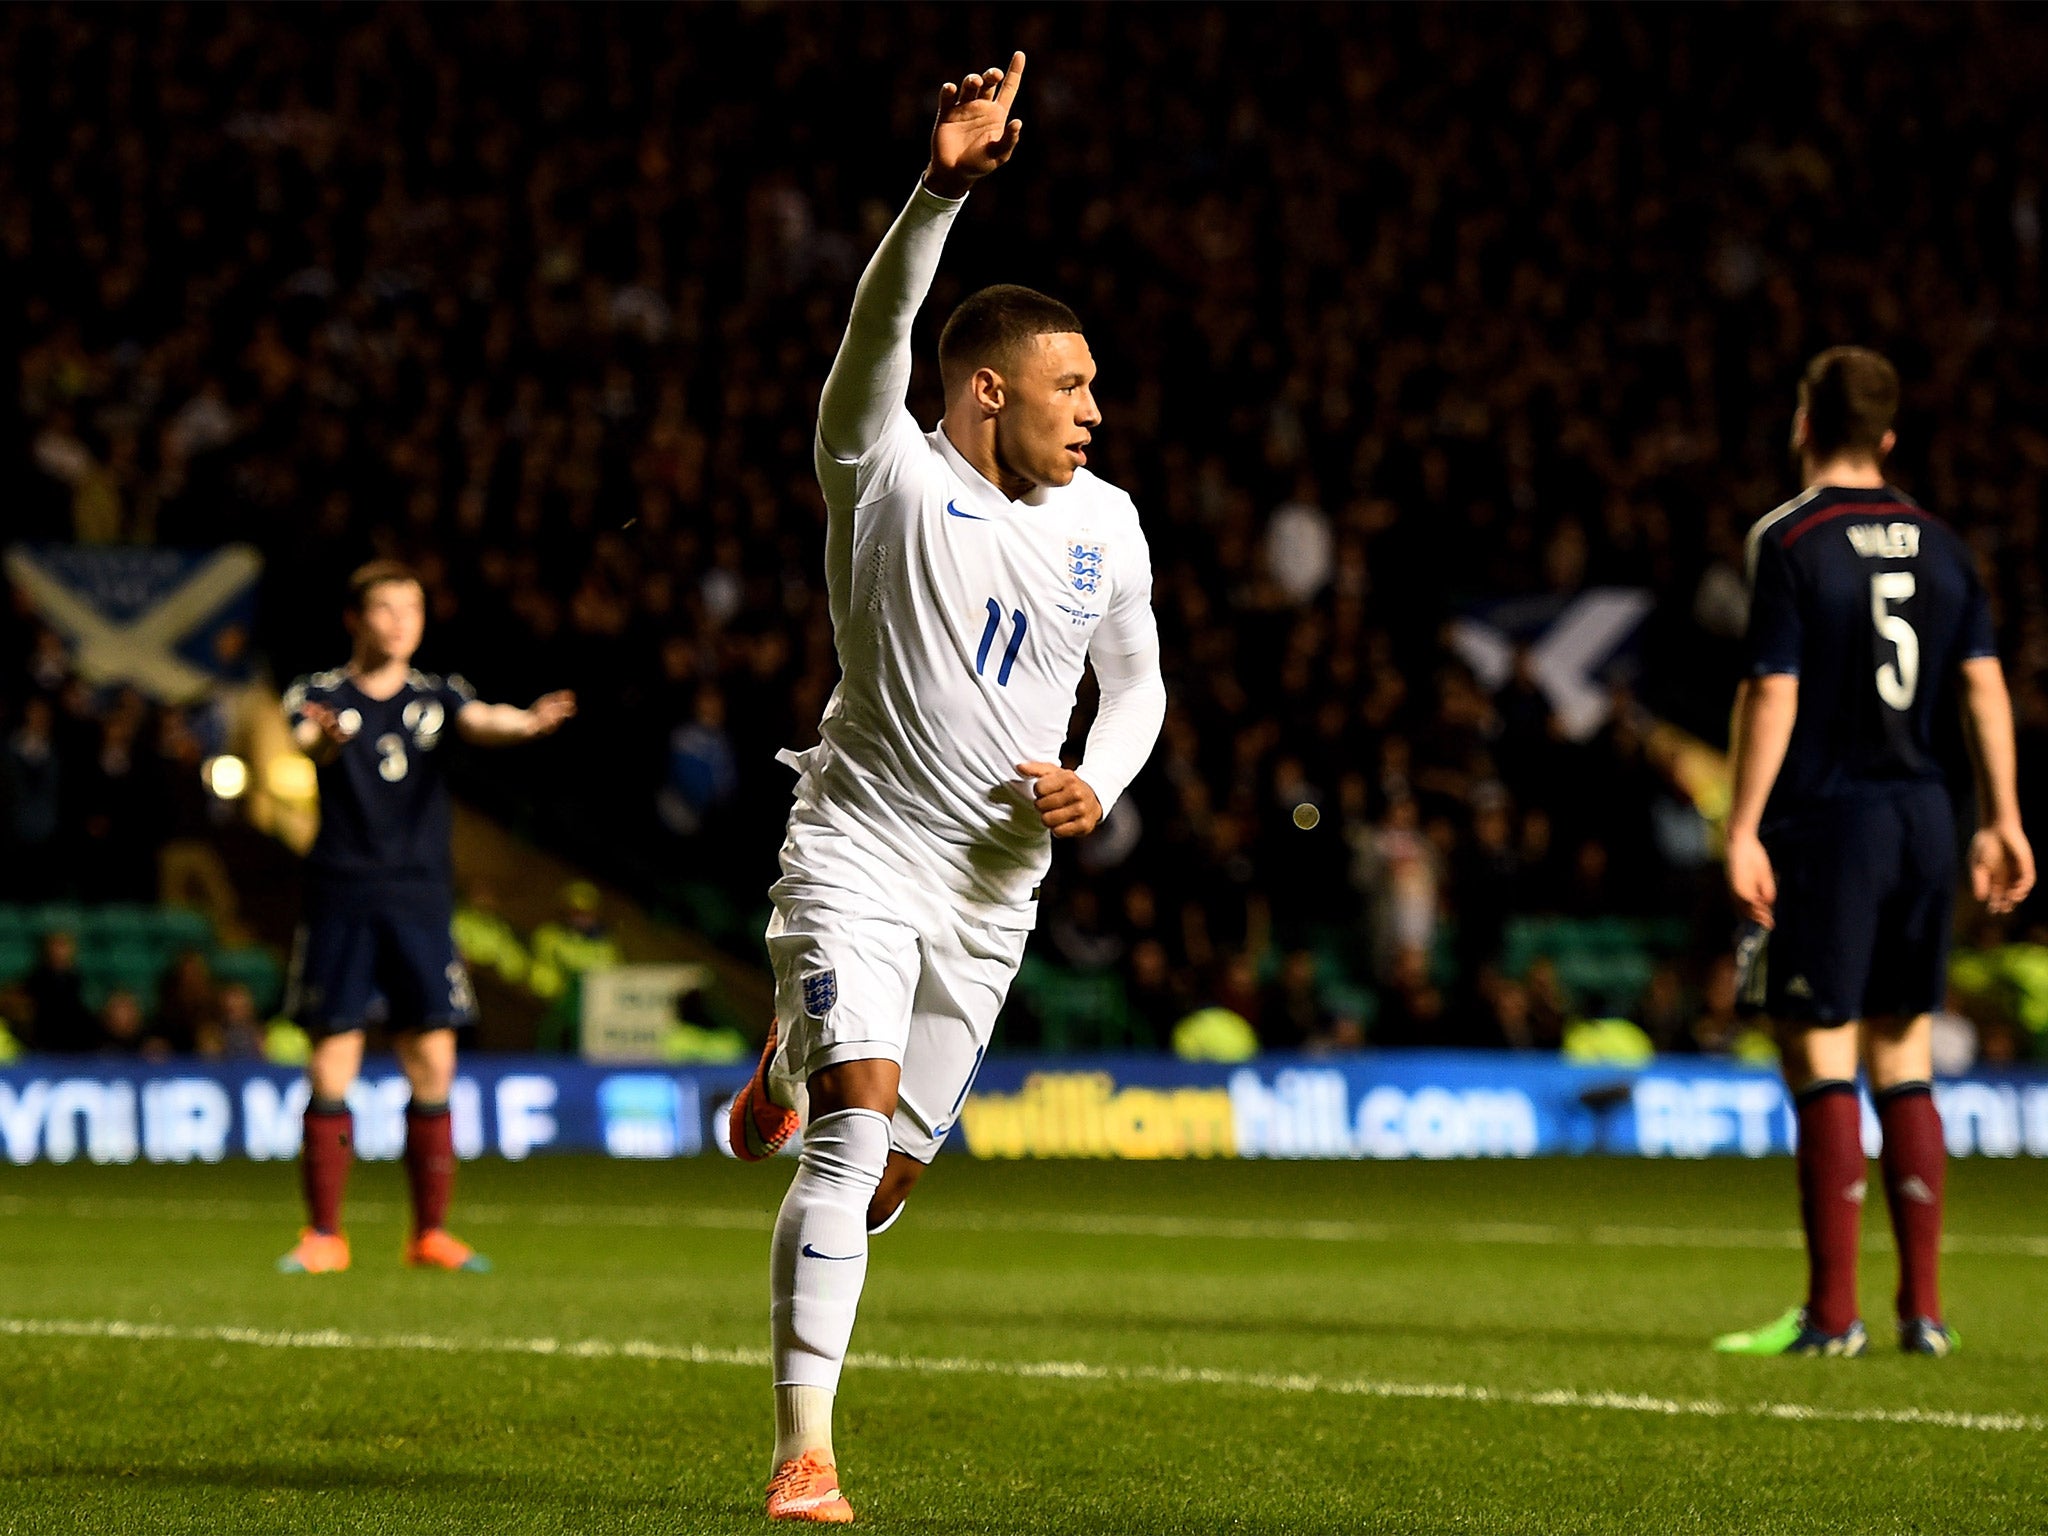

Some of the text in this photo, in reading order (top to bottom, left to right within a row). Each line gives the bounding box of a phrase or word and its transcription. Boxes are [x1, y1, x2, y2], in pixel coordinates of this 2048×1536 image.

[976, 597, 1028, 688] 11
[1870, 571, 1919, 711] 5
[375, 732, 409, 782] 3
[963, 1069, 1538, 1160] williamhill.com
